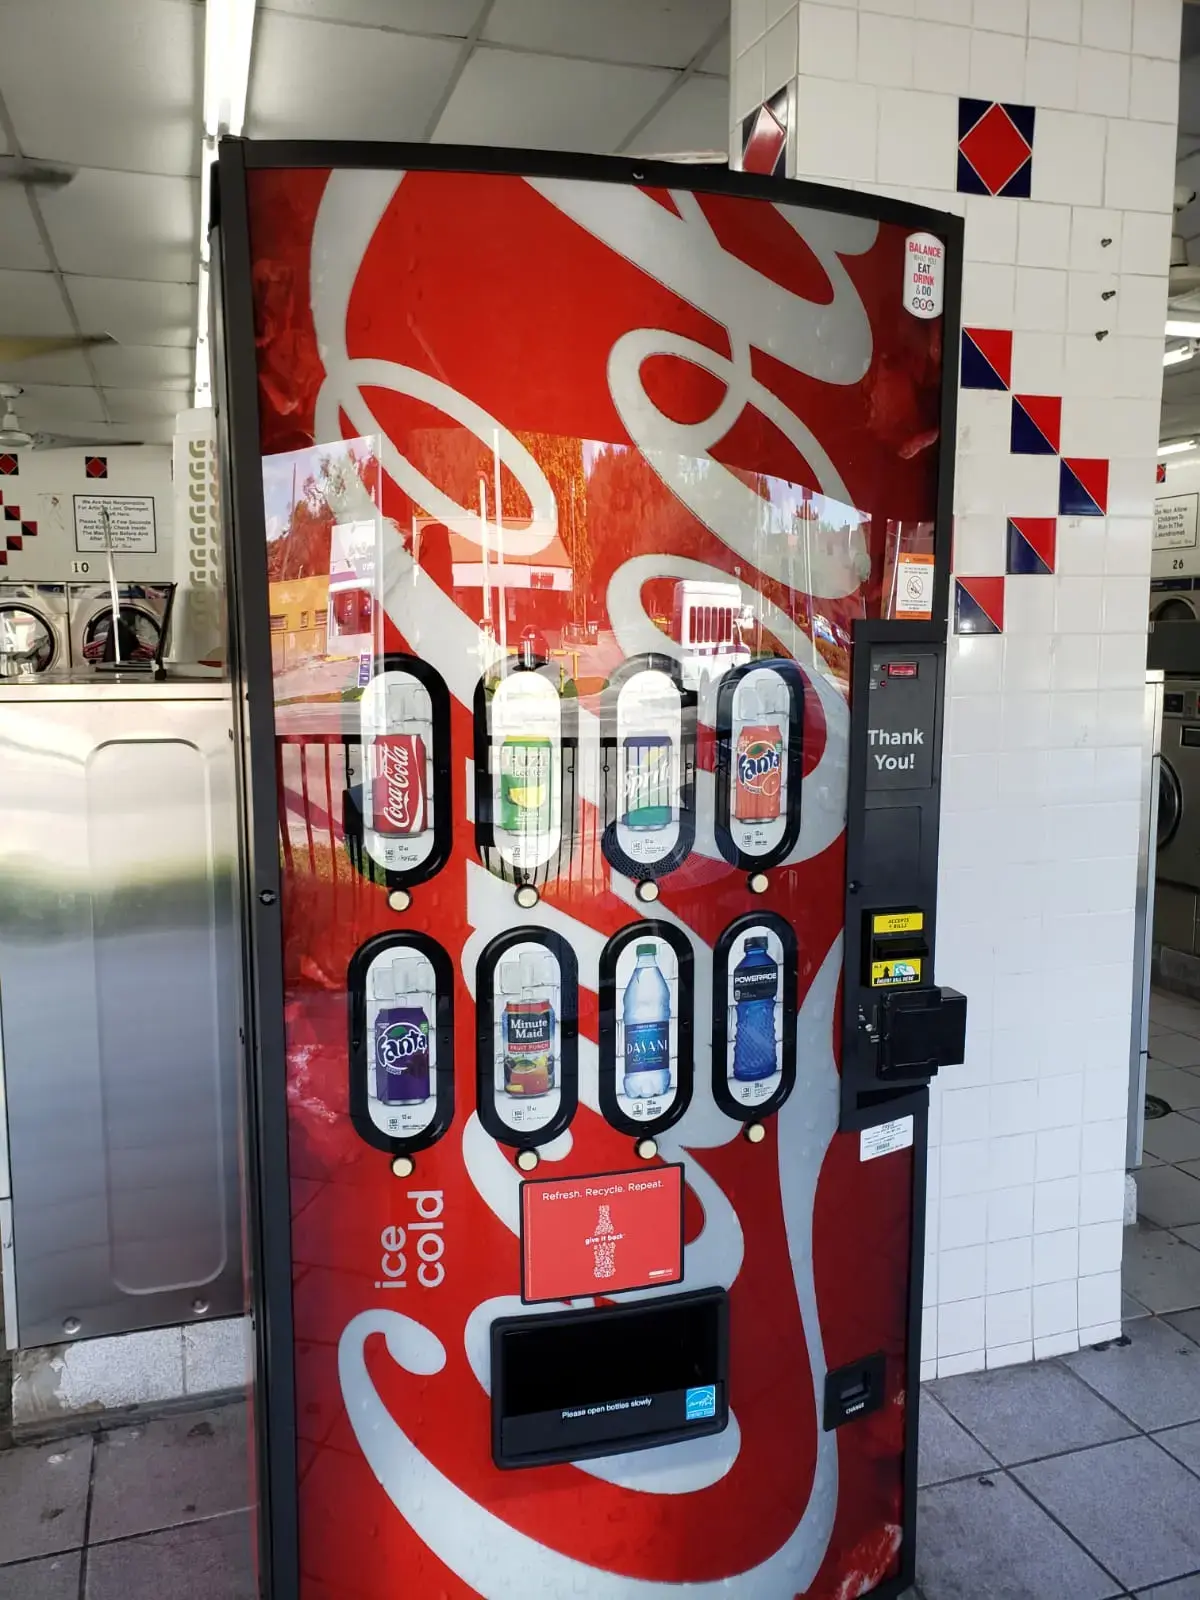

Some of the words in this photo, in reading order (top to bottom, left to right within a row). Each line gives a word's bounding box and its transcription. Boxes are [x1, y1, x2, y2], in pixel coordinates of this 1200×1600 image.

[909, 242, 941, 258] BALANCE
[918, 262, 931, 274] EAT
[913, 273, 935, 286] DRINK
[922, 286, 932, 296] DO
[74, 562, 89, 573] 10
[1172, 559, 1184, 570] 26
[867, 728, 924, 746] Thank
[874, 753, 915, 770] You!
[734, 973, 777, 984] POWERADE
[510, 1019, 548, 1029] Minute
[515, 1028, 543, 1039] Maid
[626, 1040, 668, 1054] DASANI
[542, 1190, 583, 1201] Refresh.
[585, 1184, 626, 1197] Recycle.
[628, 1179, 664, 1192] Repeat.
[406, 1190, 445, 1288] cold
[585, 1235, 599, 1245] give
[374, 1225, 407, 1288] ice
[561, 1408, 586, 1419] Please
[587, 1405, 605, 1416] open
[606, 1401, 630, 1412] bottles
[630, 1397, 652, 1408] slowly
